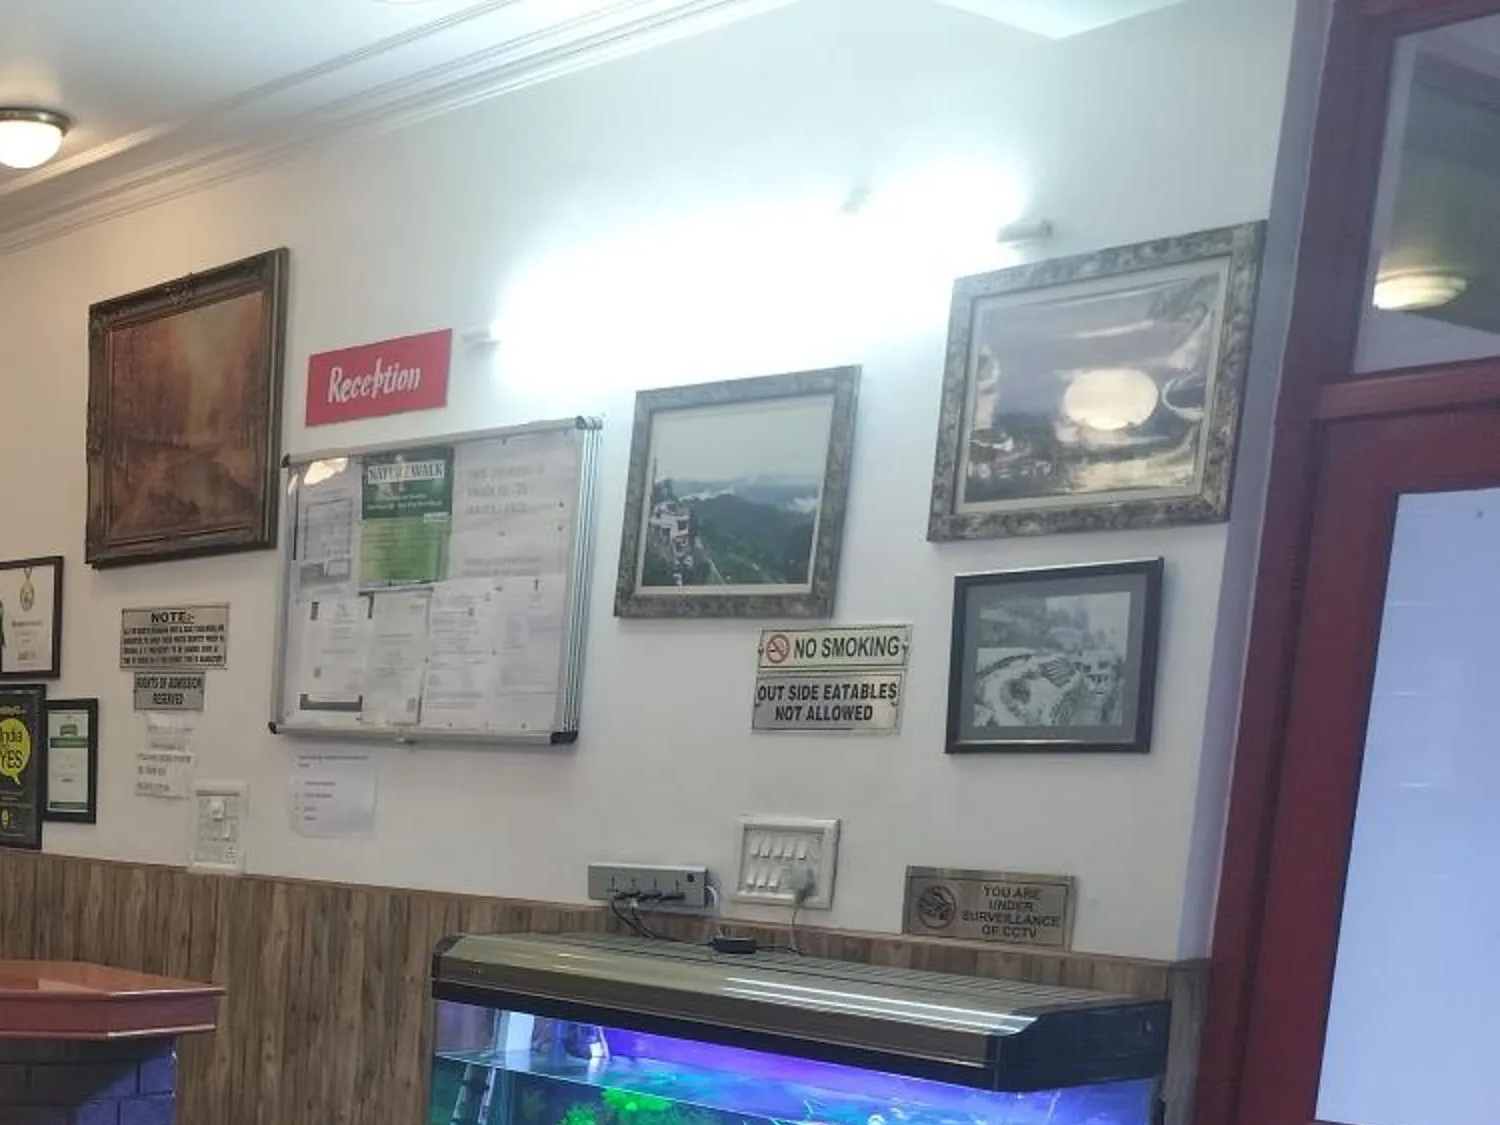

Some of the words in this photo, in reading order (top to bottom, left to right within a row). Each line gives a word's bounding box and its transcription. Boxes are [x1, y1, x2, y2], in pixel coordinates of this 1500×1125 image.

[327, 357, 421, 403] Reception
[794, 637, 817, 659] NO
[821, 634, 901, 659] SMOKING
[757, 685, 786, 701] OUT
[787, 684, 819, 701] SIDE
[822, 682, 898, 700] EATABLES
[775, 705, 804, 721] NOT
[805, 704, 874, 721] ALLOWED
[0, 749, 23, 769] YES
[982, 884, 1011, 898] YOU
[1012, 887, 1043, 901] ARE
[989, 900, 1034, 912] UNDER
[961, 909, 1061, 928] SURVEILLANCE
[981, 924, 998, 937] OF
[1003, 926, 1037, 939] CCTV
